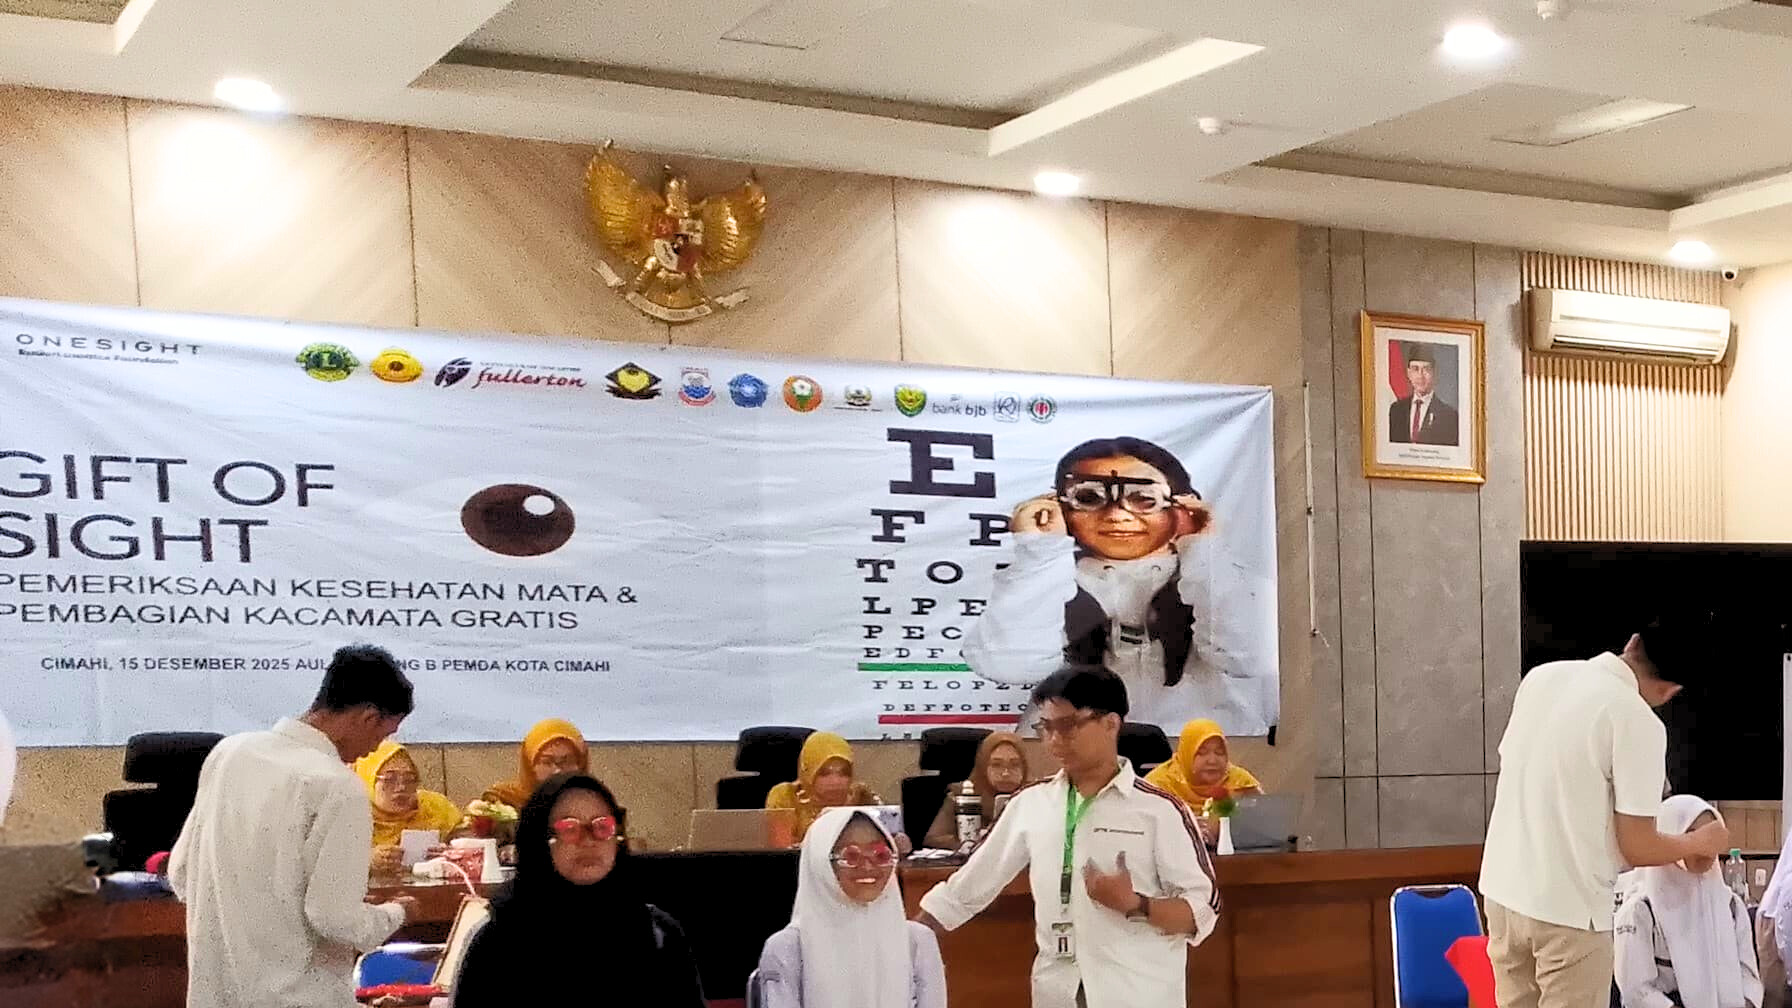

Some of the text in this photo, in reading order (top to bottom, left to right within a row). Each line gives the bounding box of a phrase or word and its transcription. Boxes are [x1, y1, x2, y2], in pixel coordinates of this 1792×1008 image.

[16, 333, 204, 355] ONESIGHT
[471, 367, 588, 389] fullerton
[932, 402, 987, 418] bank bjb
[887, 427, 997, 499] E
[0, 450, 335, 507] GIFT OF
[0, 511, 269, 563] SIGHT
[0, 573, 638, 604] PEMERIKSAAN KESEHATAN MATA &
[0, 603, 579, 629] PEMBAGIAN KACAMATA GRATIS
[41, 657, 113, 671] CIMAHI,
[121, 657, 139, 670] 15
[144, 657, 246, 671] DESEMBER
[251, 657, 290, 671] 2025
[295, 658, 330, 671] AUL
[425, 659, 437, 671] B
[442, 659, 501, 672] PEMDA
[505, 660, 550, 673] KOTA
[554, 660, 610, 673] CIMAHI
